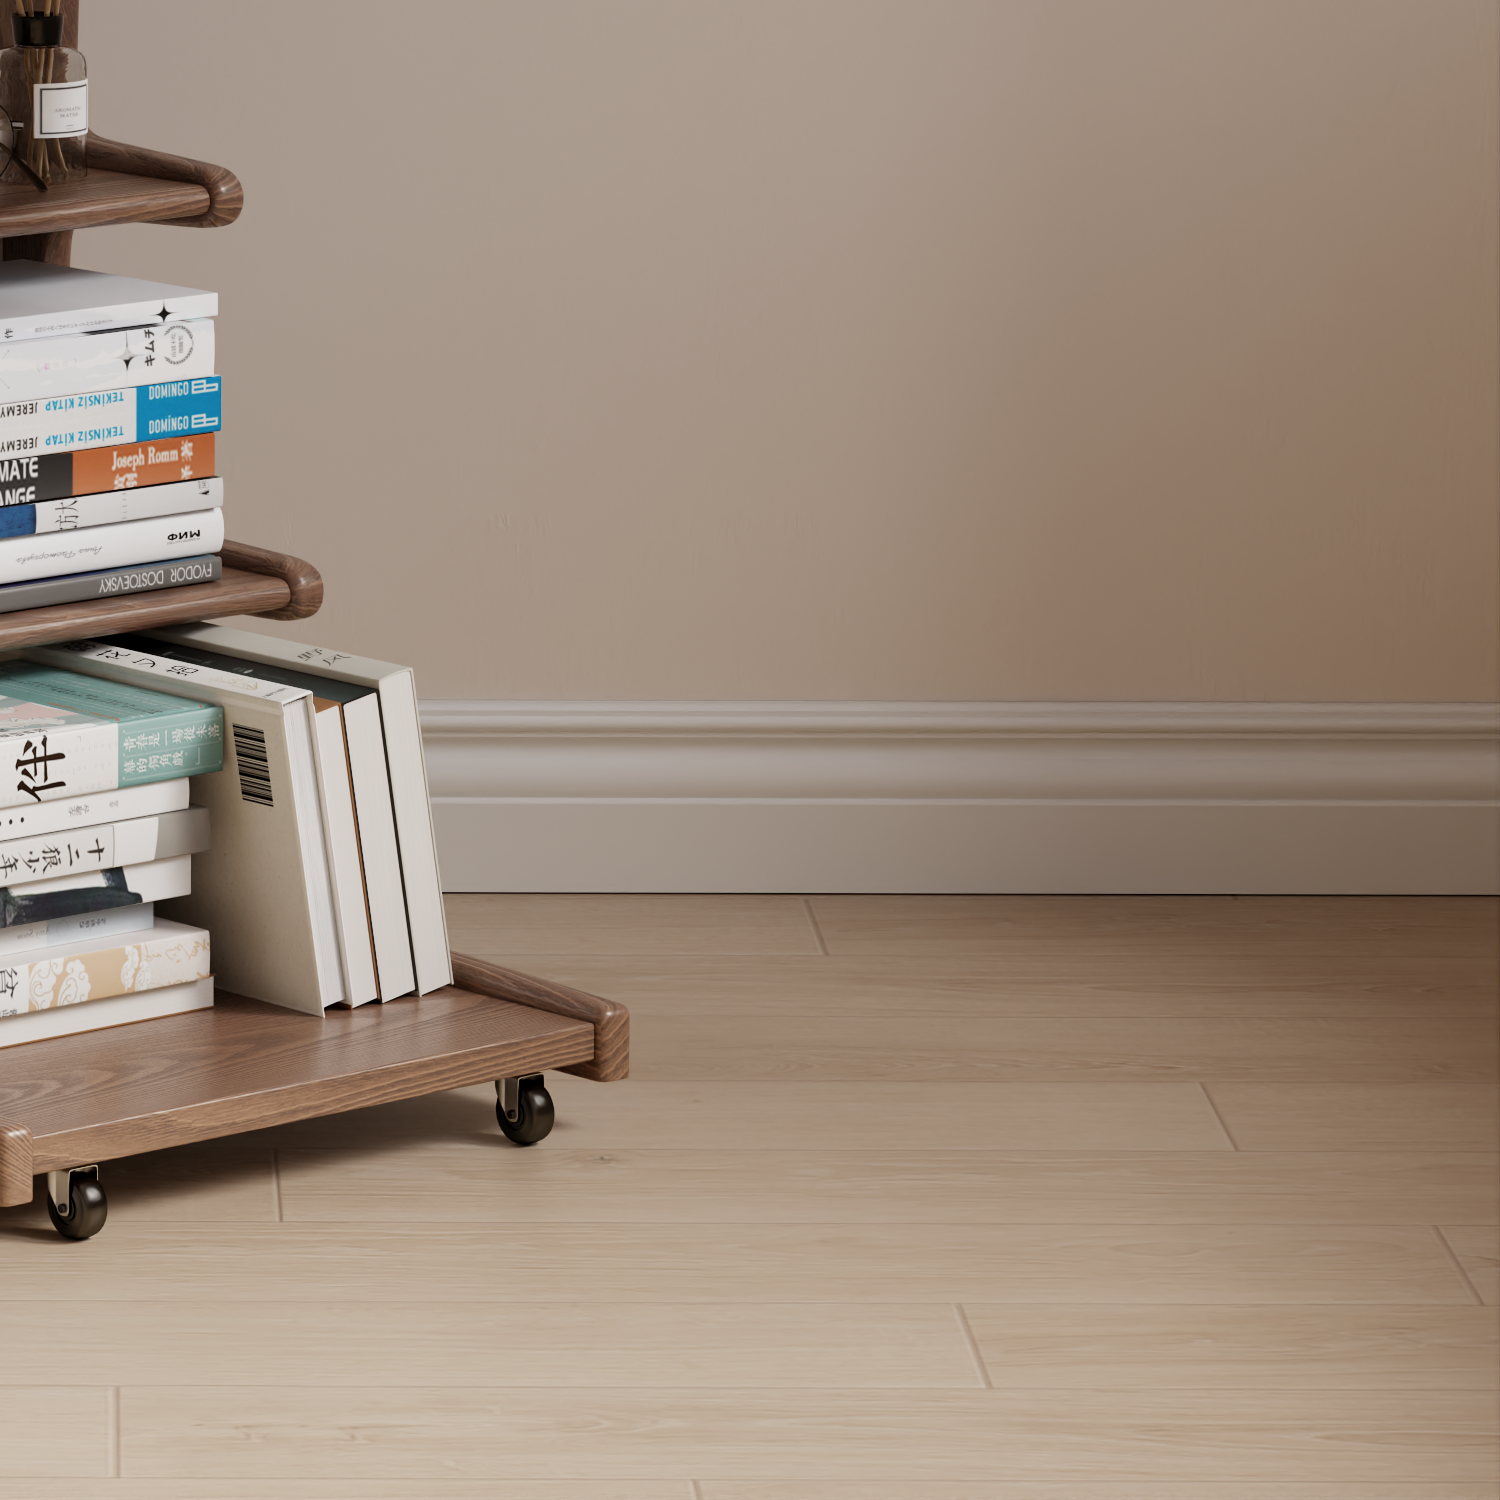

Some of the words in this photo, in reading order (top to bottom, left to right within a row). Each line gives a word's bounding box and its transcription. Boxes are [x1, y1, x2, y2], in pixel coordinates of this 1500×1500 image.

[53, 105, 82, 113] AROMATIC
[144, 329, 155, 367] キムチ
[45, 397, 75, 412] KİTAP
[77, 391, 124, 408] TEKİNSİZ
[0, 401, 38, 418] JEREMY
[45, 431, 75, 447] KİTAP
[77, 426, 124, 443] TEKİNSİZ
[0, 437, 38, 453] JEREMY
[112, 448, 145, 471] Joseph
[148, 446, 179, 465] Romm
[167, 529, 201, 541] МИФ
[170, 562, 212, 583] FYODOR
[98, 570, 164, 594] DOSTOEVSKY
[15, 735, 67, 802] 伴
